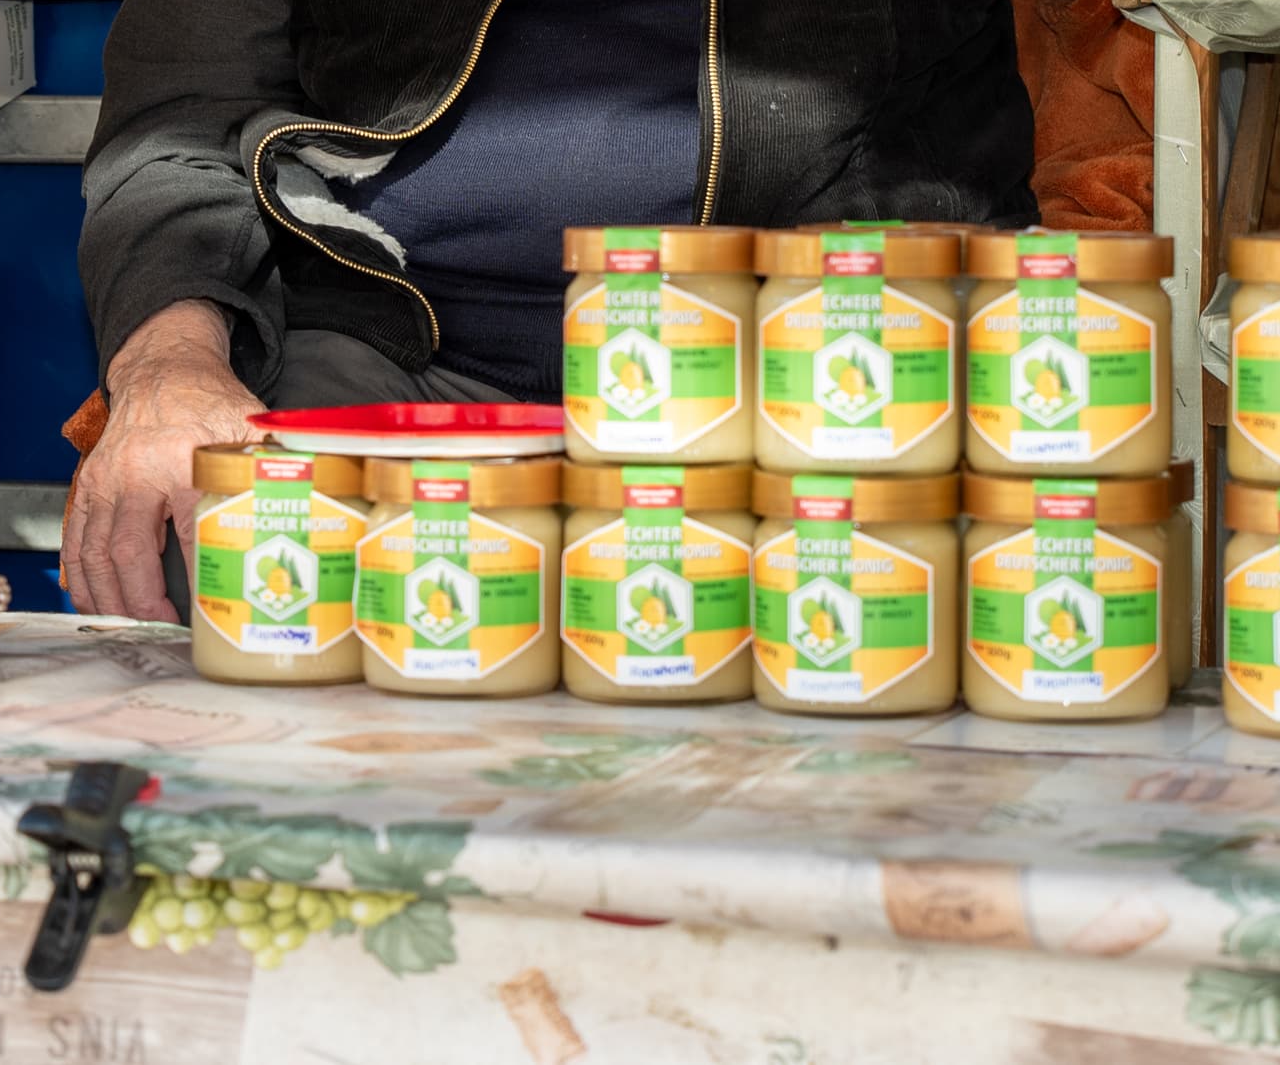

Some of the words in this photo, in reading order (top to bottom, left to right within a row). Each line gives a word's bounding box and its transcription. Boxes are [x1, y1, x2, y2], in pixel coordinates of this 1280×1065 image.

[821, 294, 882, 311] ECHTER
[1017, 297, 1077, 314] ECHTER
[784, 312, 869, 331] DEUTSCHER
[872, 313, 921, 330] HONIG
[985, 313, 1065, 332] DEUTSCHER
[1067, 314, 1120, 331] HONIG
[253, 498, 310, 515] ECHTER
[219, 513, 297, 532] DEUTSCHER
[301, 516, 348, 532] HONIG
[413, 519, 469, 535] ECHTER
[624, 526, 682, 542] ECHTER
[382, 537, 456, 555] DEUTSCHER
[460, 537, 510, 554] HONIG
[589, 542, 669, 561] DEUTSCHER
[673, 543, 722, 560] HONIG
[795, 538, 852, 555] ECHTER
[1033, 537, 1094, 555] ECHTER
[766, 555, 837, 573] DEUTSCHER
[841, 557, 894, 574] HONIG
[995, 555, 1080, 574] DEUTSCHER
[1083, 556, 1133, 573] HONIG
[47, 1015, 147, 1064] VINS
